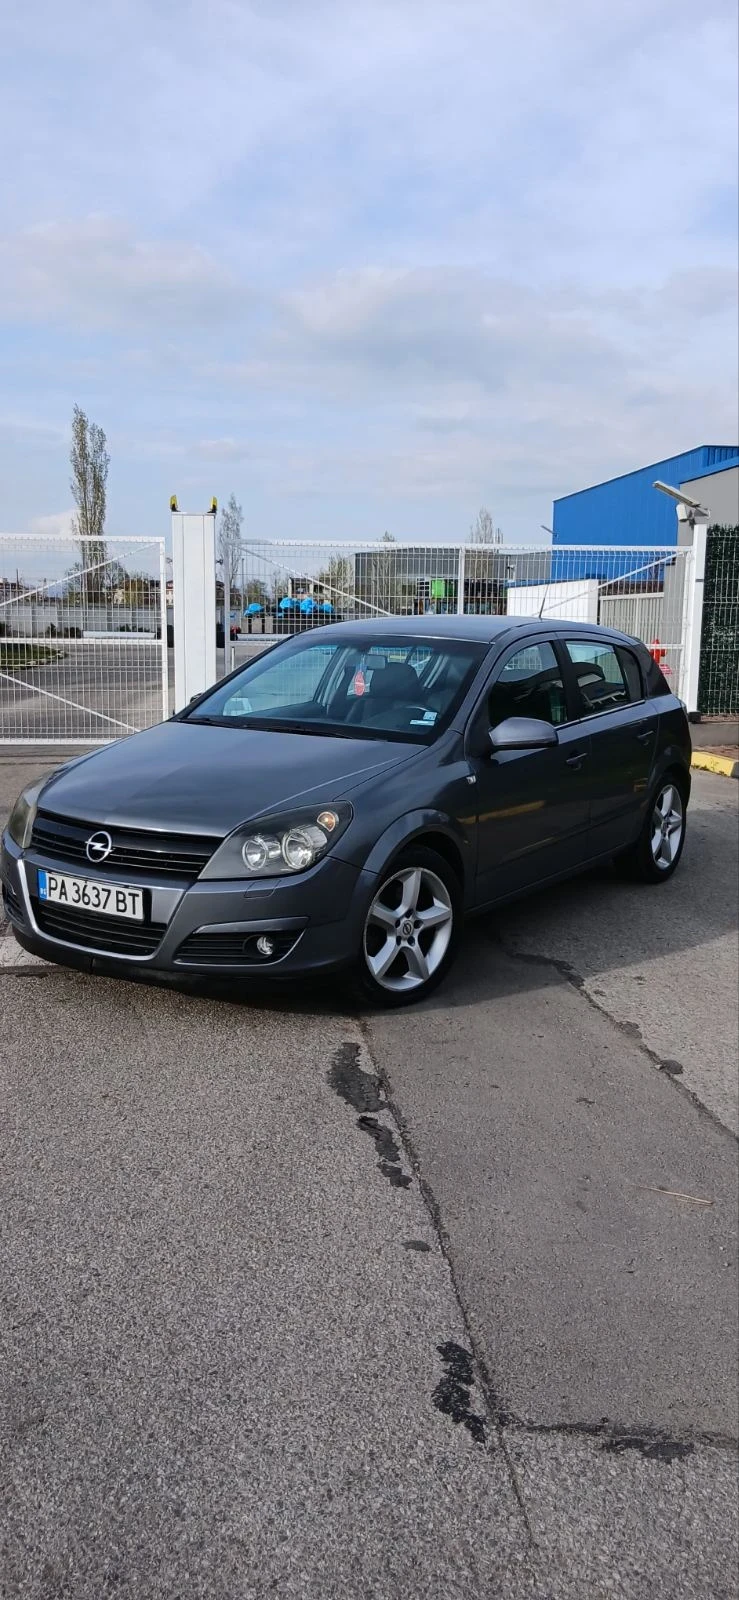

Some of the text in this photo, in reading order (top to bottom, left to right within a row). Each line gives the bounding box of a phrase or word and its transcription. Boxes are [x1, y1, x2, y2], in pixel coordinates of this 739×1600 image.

[48, 877, 139, 915] PA 3637 BT
